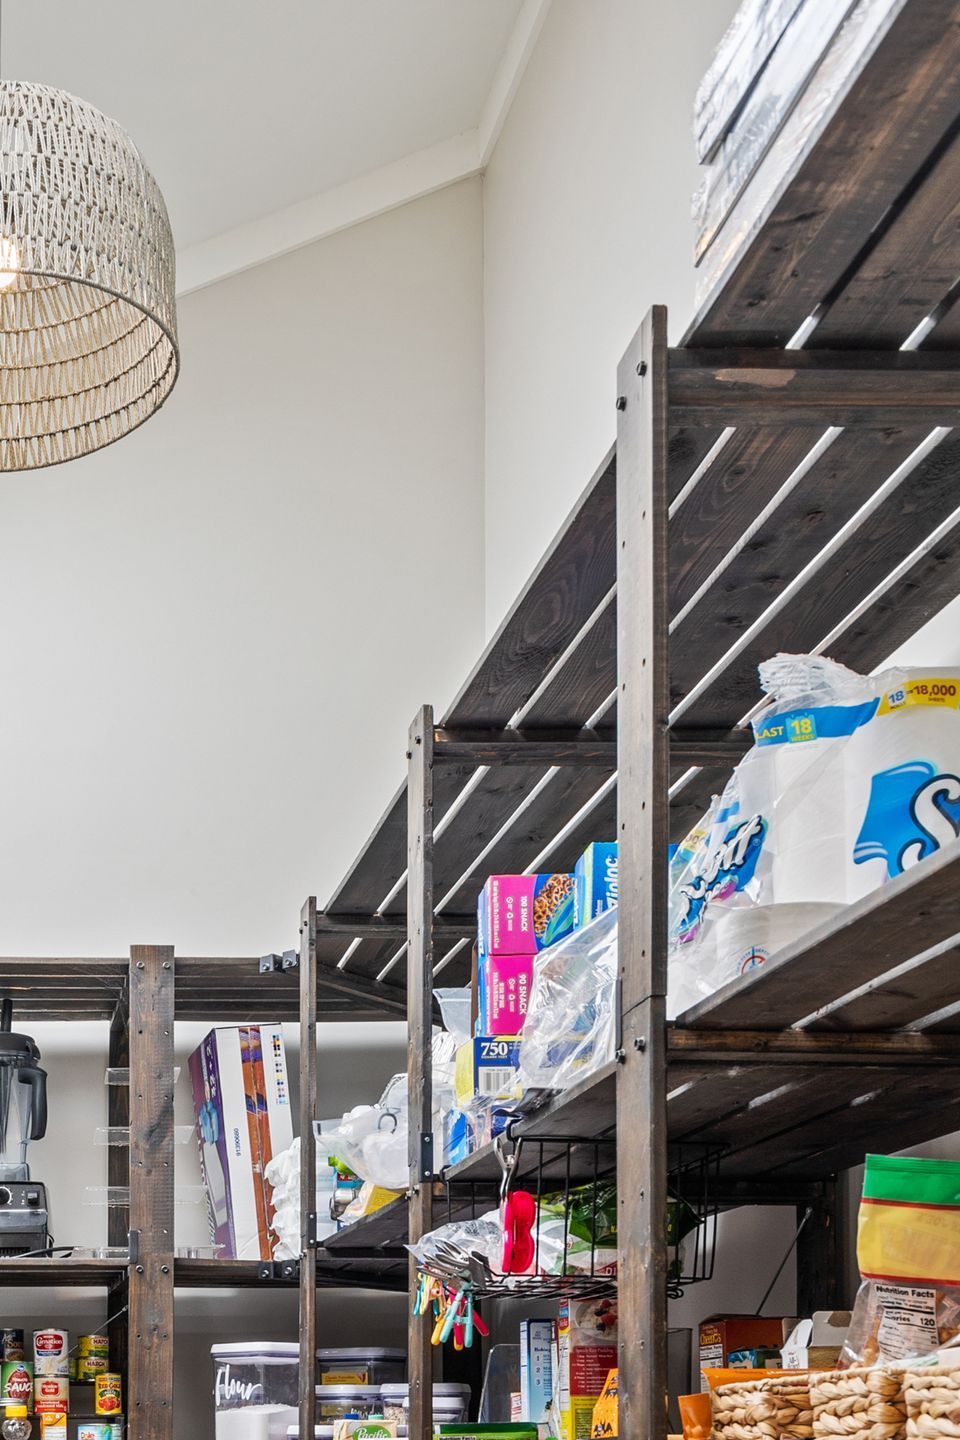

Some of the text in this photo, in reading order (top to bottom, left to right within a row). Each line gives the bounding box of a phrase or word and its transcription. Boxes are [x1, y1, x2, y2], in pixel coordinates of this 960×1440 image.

[888, 684, 957, 704] 18 18,000
[755, 718, 813, 740] LAST 18
[520, 895, 528, 932] 100 SNACK
[519, 974, 528, 1015] 90 SNACK
[480, 1041, 509, 1056] 750
[876, 1285, 935, 1298] Nutrition Facts
[920, 1318, 935, 1327] 120
[36, 1337, 63, 1347] Carnation
[80, 1431, 95, 1440] Dole
